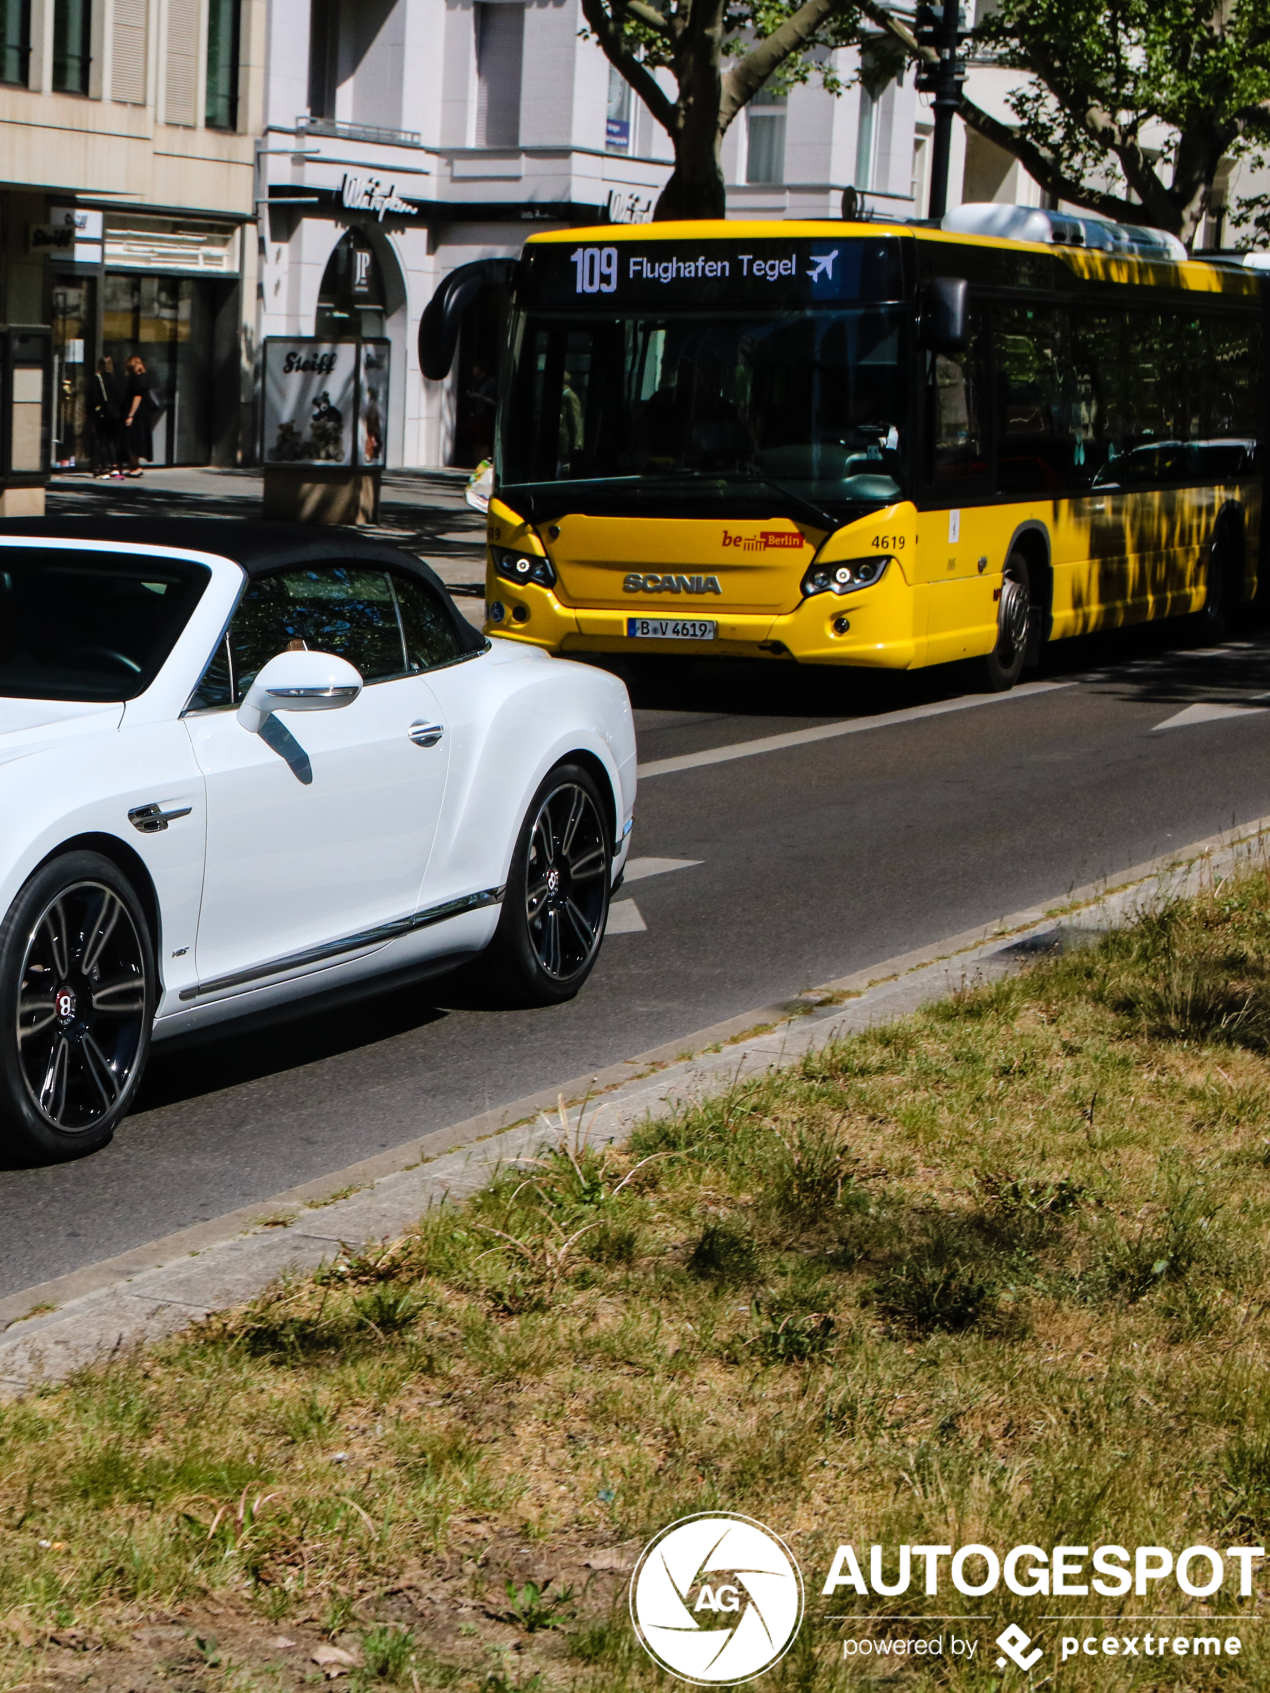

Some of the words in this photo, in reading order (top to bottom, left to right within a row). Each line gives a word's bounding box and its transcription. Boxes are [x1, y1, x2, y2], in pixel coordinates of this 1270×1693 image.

[570, 247, 618, 293] 109
[630, 257, 730, 283] Flughafen
[738, 254, 796, 281] Tegel
[283, 351, 337, 375] Steiff
[721, 530, 743, 548] be
[767, 535, 800, 547] Berlin
[871, 535, 906, 550] 4619
[622, 573, 723, 595] SCANIA
[640, 621, 650, 635] B
[659, 622, 669, 636] V
[672, 623, 708, 637] 4619
